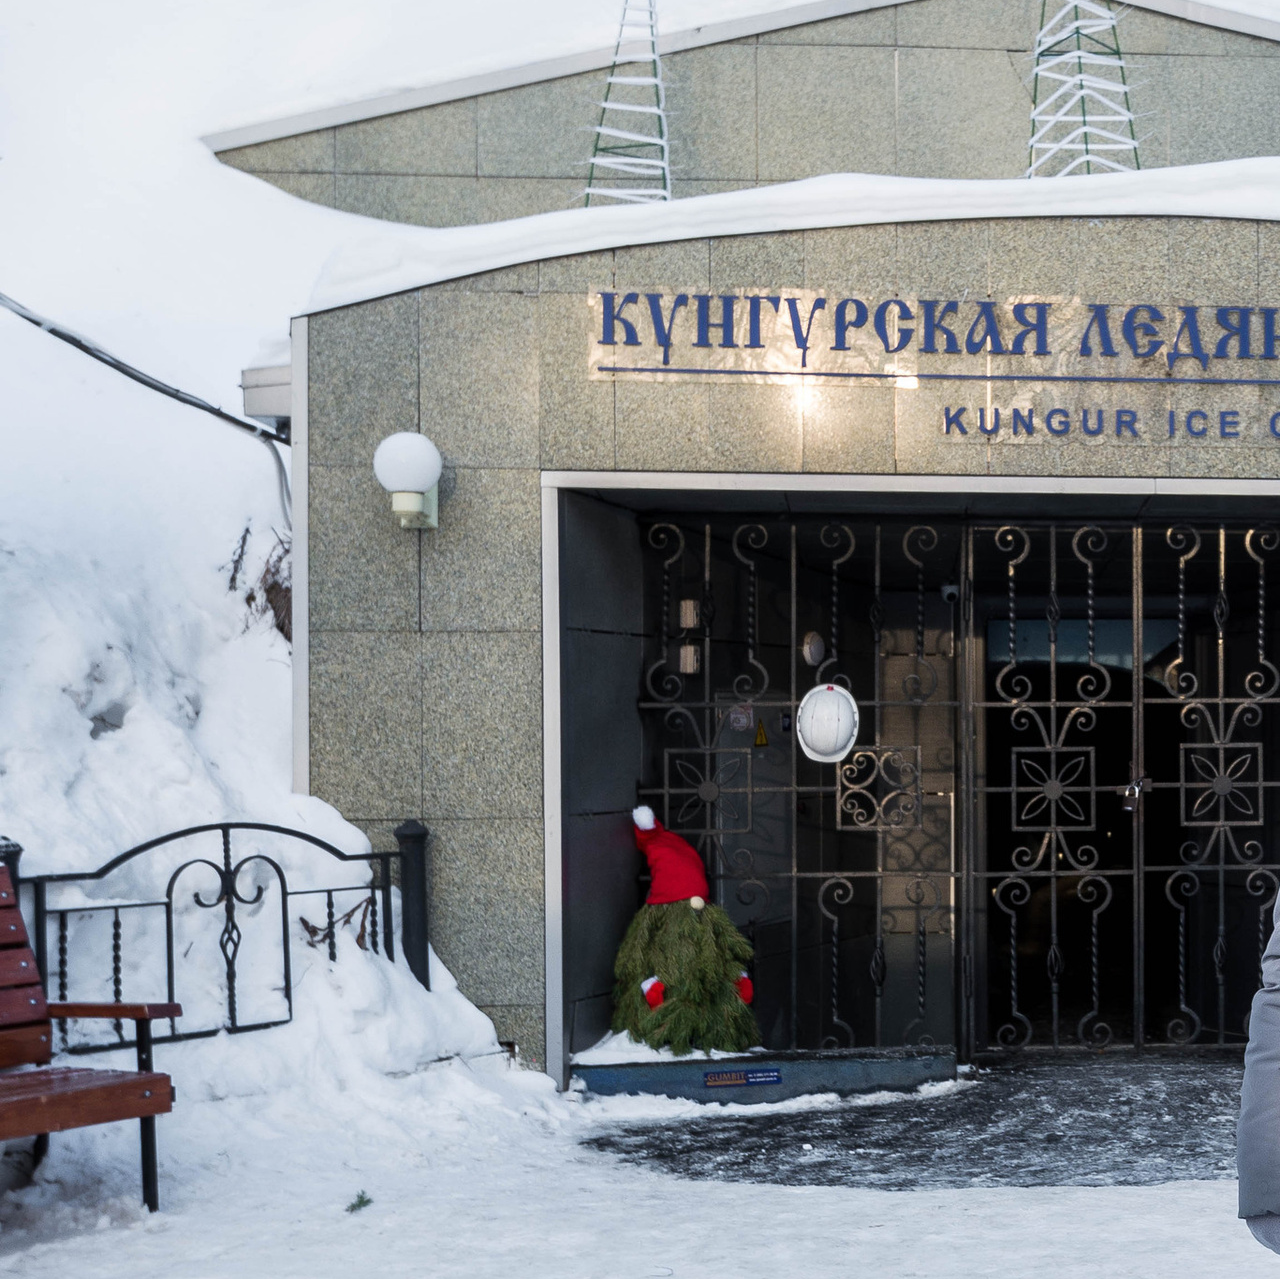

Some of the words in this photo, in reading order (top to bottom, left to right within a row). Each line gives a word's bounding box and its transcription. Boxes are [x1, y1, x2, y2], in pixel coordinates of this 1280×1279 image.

[597, 292, 1052, 368] КУНГУРСКАЯ
[944, 406, 1140, 436] KUNGUR
[1168, 410, 1240, 438] ICE
